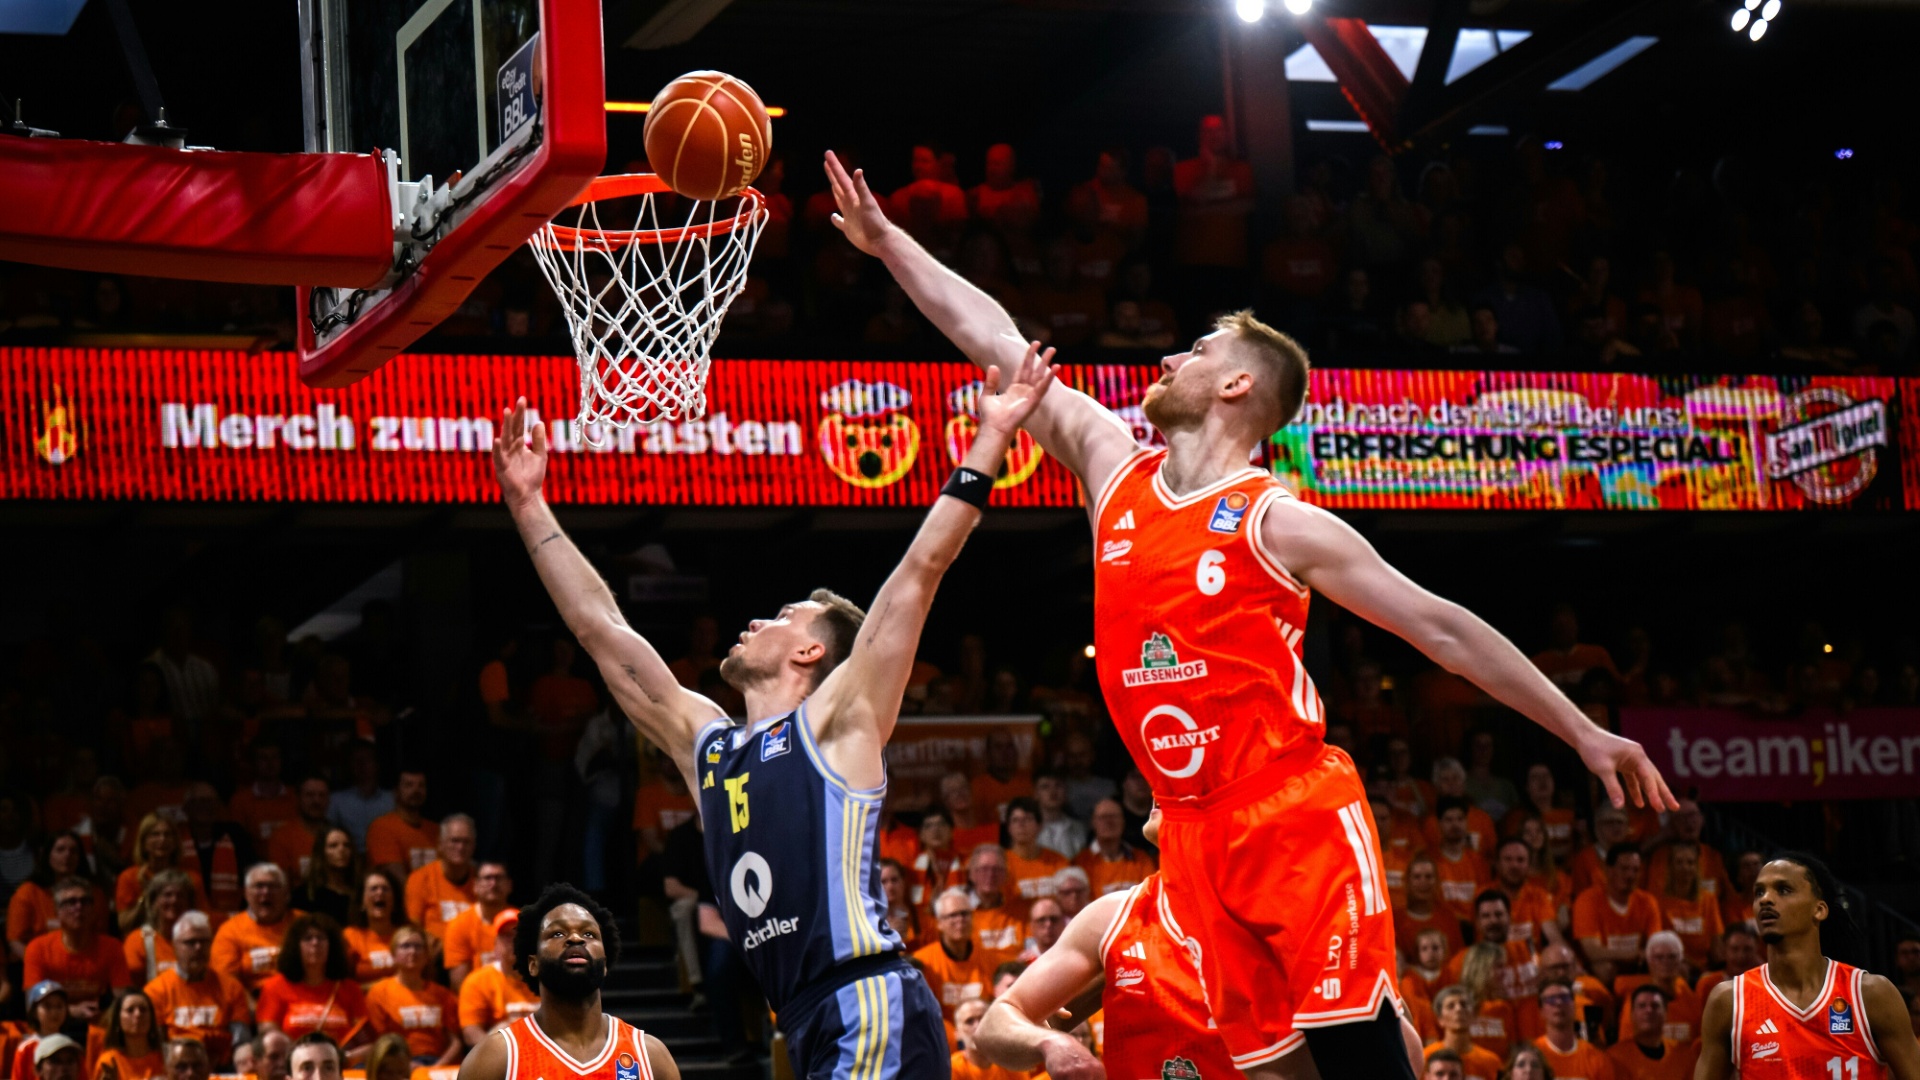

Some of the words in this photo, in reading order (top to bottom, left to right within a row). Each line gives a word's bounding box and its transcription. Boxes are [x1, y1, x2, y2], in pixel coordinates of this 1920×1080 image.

[504, 93, 528, 139] BBL
[161, 402, 356, 450] Merch
[370, 416, 493, 452] zum
[1352, 398, 1423, 428] nach
[1313, 432, 1558, 461] ERFRISCHUNG
[1567, 435, 1743, 463] ESPECIAL!
[1196, 549, 1227, 596] 6
[1125, 662, 1204, 685] WIESENHOF
[1150, 725, 1221, 751] MIAVIT
[723, 771, 750, 834] 15
[1348, 937, 1358, 970] meine
[1115, 966, 1145, 980] Rasta
[1831, 1022, 1851, 1031] BBL
[1750, 1041, 1779, 1054] Rasta
[1826, 1055, 1859, 1080] 11
